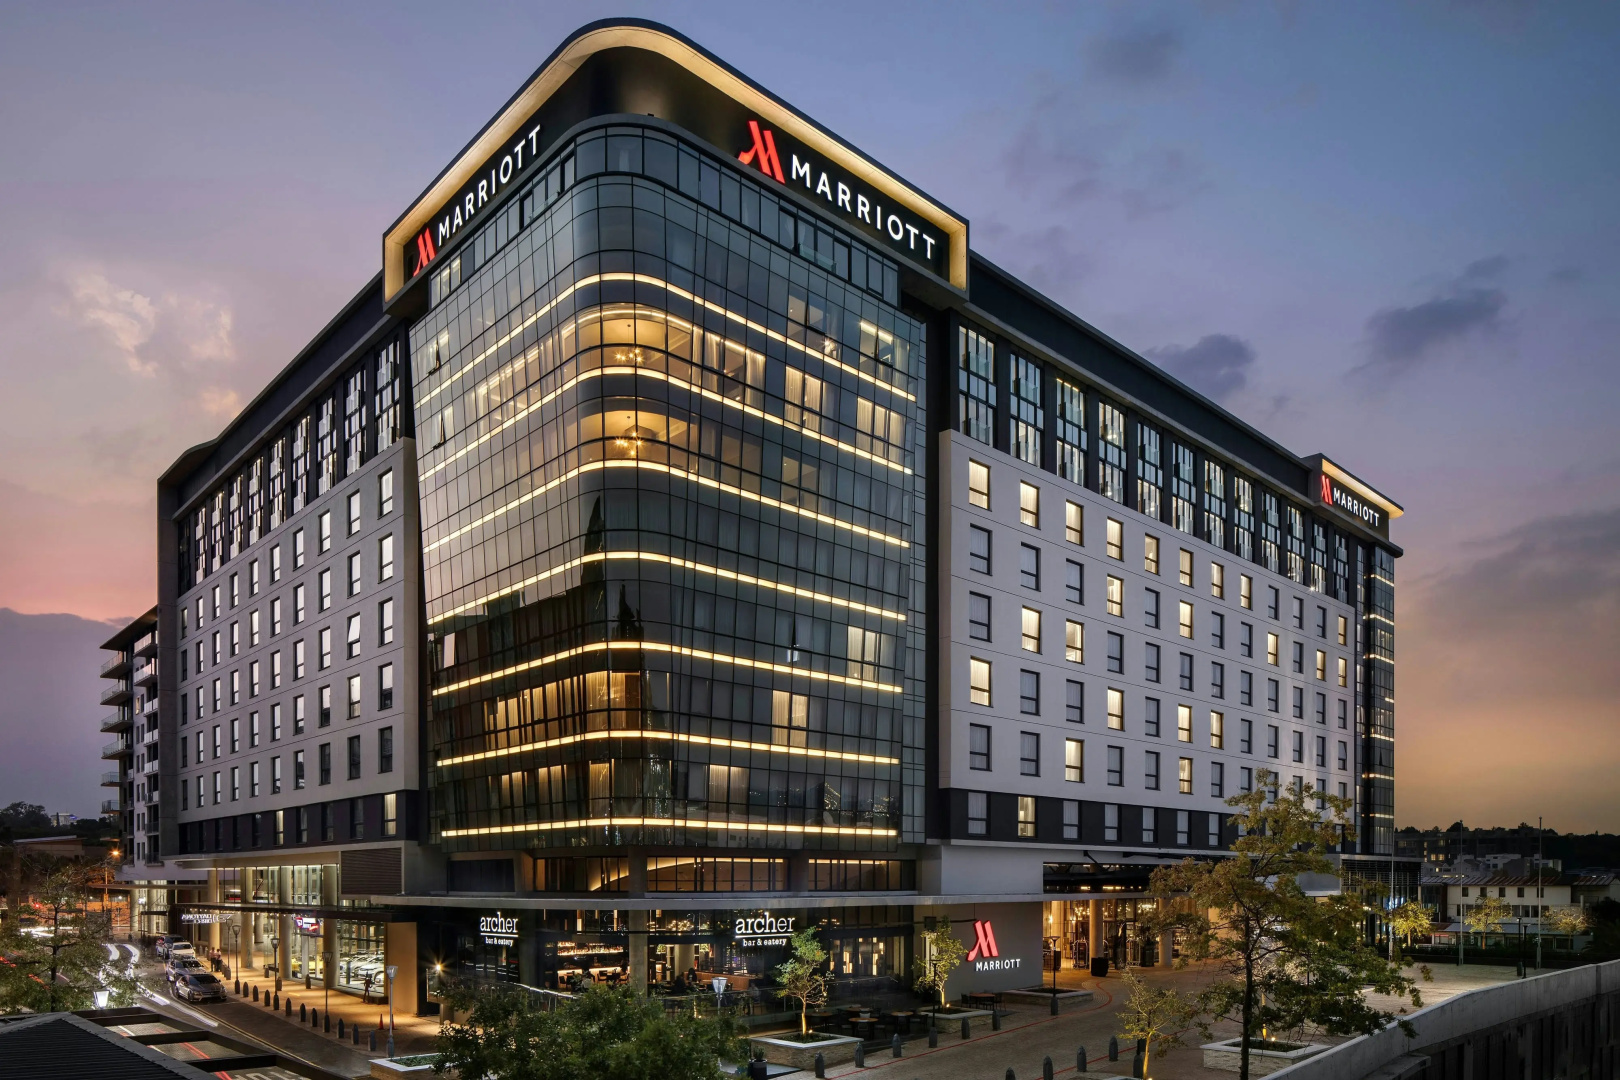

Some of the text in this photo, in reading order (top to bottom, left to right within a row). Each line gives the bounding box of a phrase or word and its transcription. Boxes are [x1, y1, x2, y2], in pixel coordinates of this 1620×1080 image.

[438, 124, 541, 247] MARRIOTT
[792, 153, 936, 260] MARRIOTT
[1333, 487, 1379, 527] MARRIOTT
[480, 912, 518, 932] archer
[735, 912, 795, 933] archer
[743, 938, 787, 947] bar & eatery
[975, 959, 1021, 971] MARRIOTT
